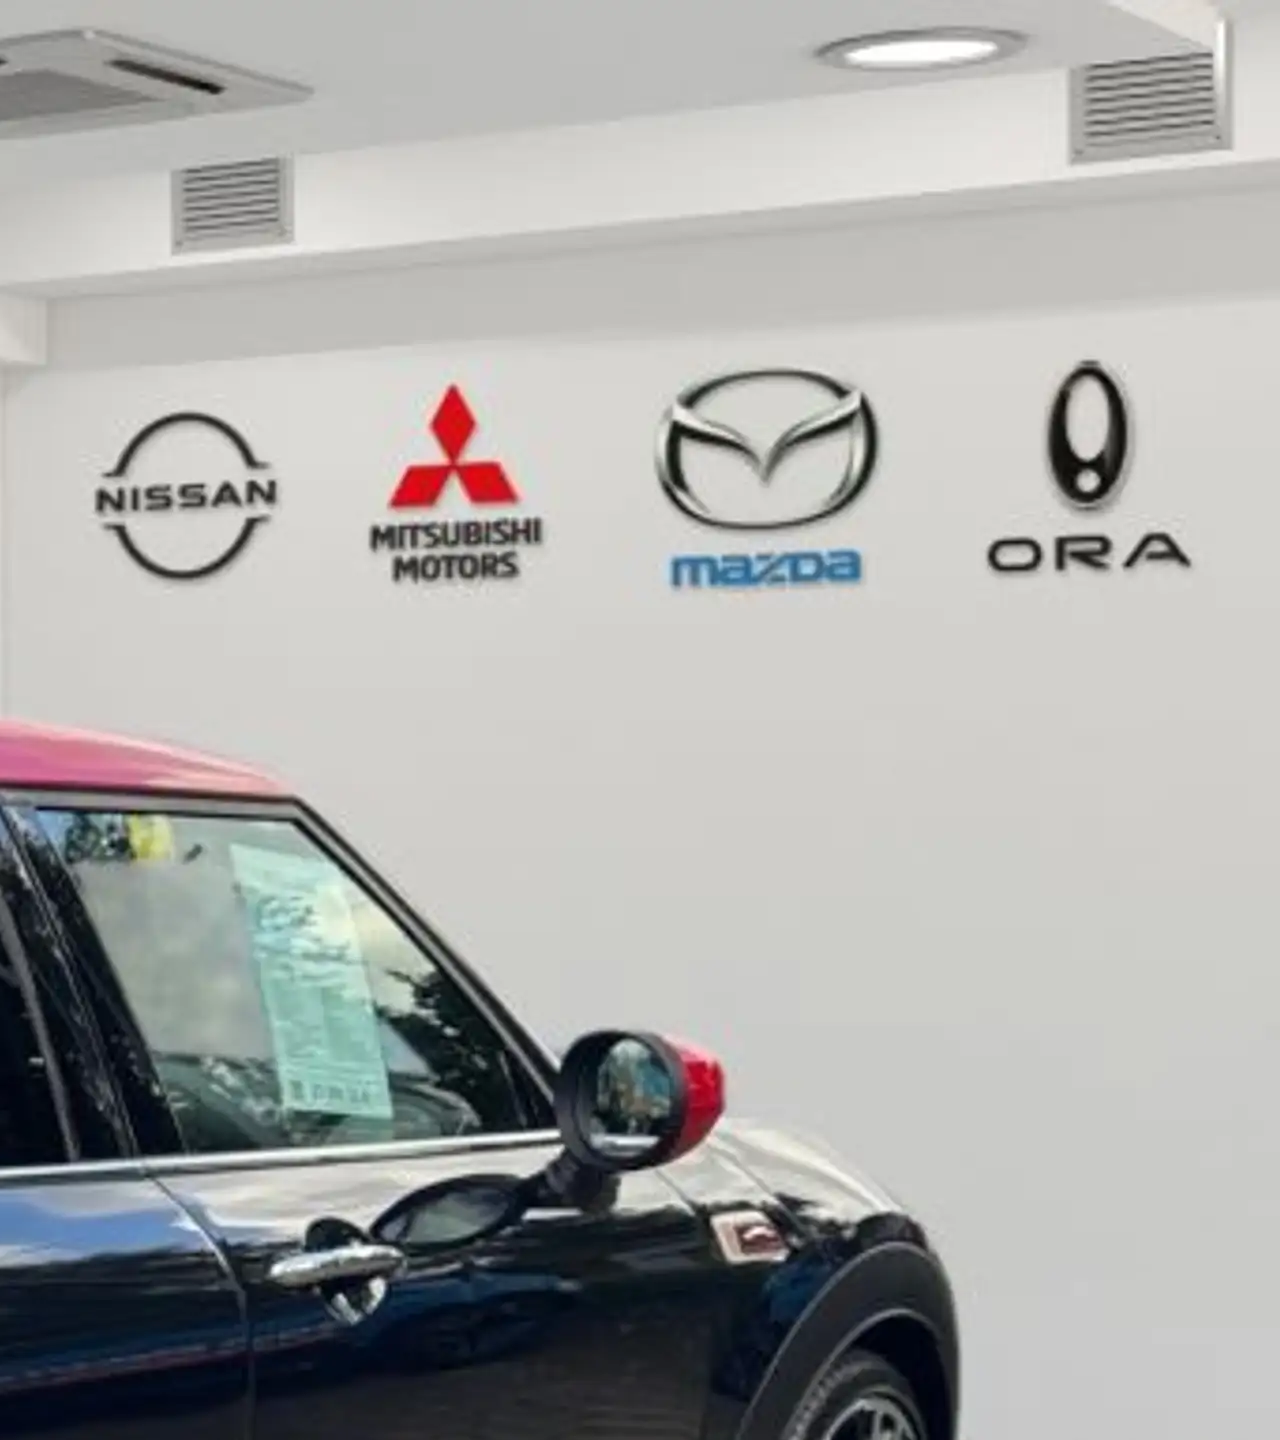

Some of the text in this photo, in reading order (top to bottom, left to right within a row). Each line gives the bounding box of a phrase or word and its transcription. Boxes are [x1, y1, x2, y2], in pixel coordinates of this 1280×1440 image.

[95, 480, 277, 513] NISSAN
[369, 517, 543, 553] MITSUBISHI
[986, 531, 1192, 573] ORA
[392, 551, 519, 583] MOTORS
[670, 548, 862, 589] mazda
